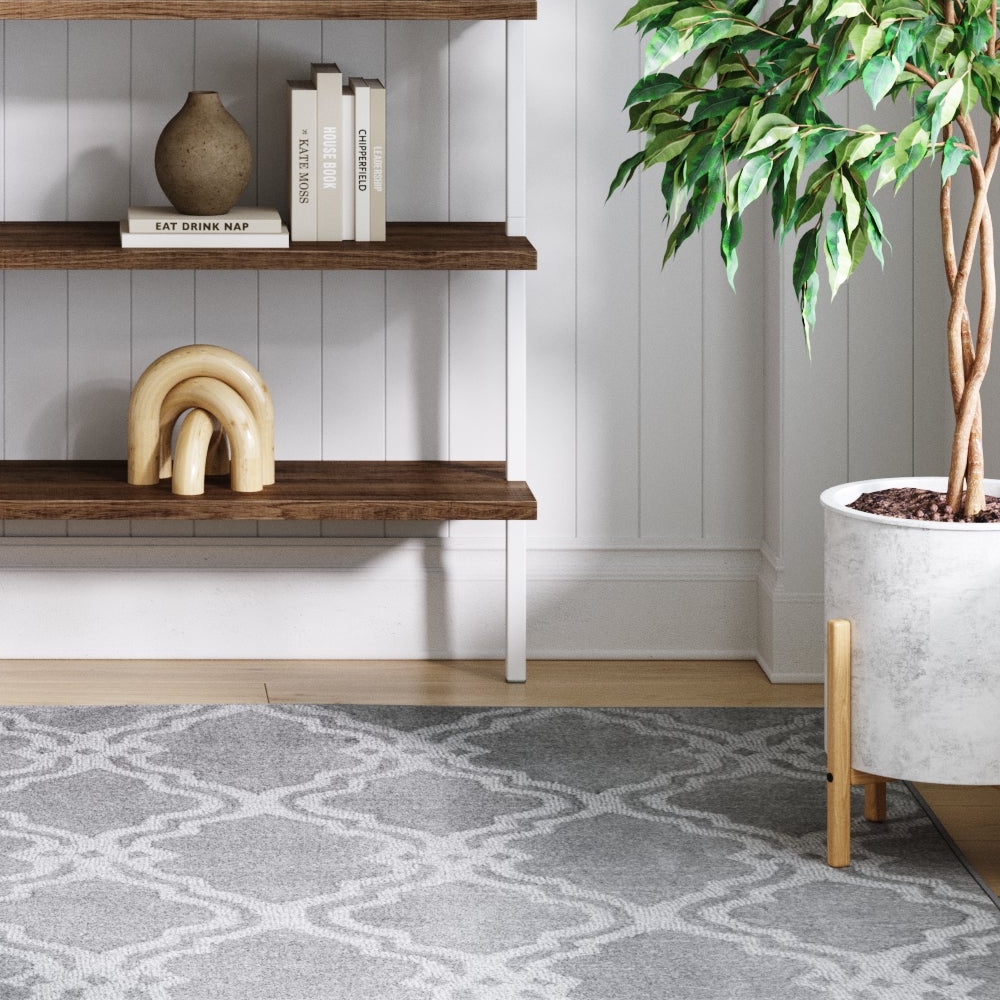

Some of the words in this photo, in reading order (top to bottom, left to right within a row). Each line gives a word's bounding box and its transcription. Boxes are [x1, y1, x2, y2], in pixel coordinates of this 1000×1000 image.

[298, 139, 309, 168] KATE
[323, 127, 337, 159] HOUSE
[323, 162, 337, 189] BOOK
[358, 129, 367, 192] CHIPPERFIELD
[298, 172, 309, 204] MOSS
[155, 222, 177, 231] EAT
[182, 222, 219, 231] DRINK
[224, 222, 249, 231] NAP
